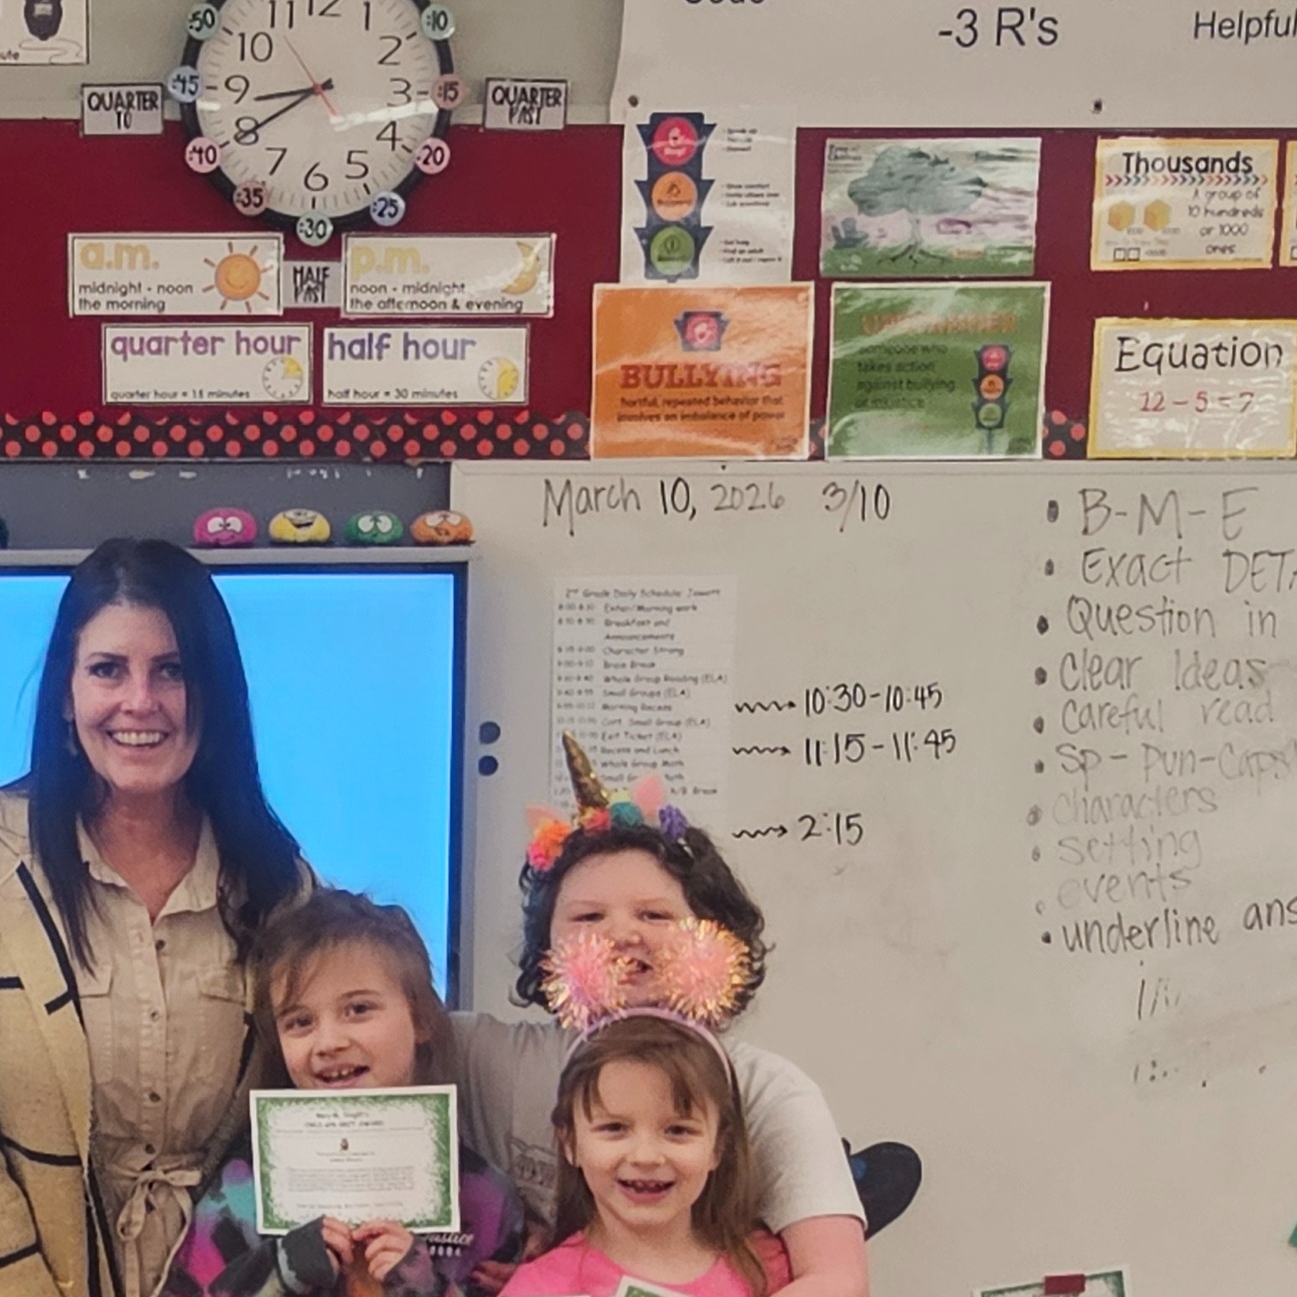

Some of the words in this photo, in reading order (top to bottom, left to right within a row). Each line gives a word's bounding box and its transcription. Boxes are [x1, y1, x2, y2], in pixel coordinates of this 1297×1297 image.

[188, 8, 215, 30] :50
[362, 2, 372, 30] 1
[426, 10, 449, 28] :10
[996, 8, 1058, 47] R's
[1194, 9, 1297, 45] Helpful
[238, 33, 273, 61] 10
[378, 36, 403, 65] 2
[172, 73, 199, 94] :45
[224, 75, 250, 104] 9
[391, 78, 411, 108] 3
[438, 82, 459, 101] :15
[491, 86, 563, 107] QUARTER
[87, 92, 159, 111] QUARTER
[508, 106, 542, 124] PAST
[115, 111, 132, 128] TO
[376, 121, 403, 150] 4
[188, 144, 217, 165] :40
[265, 147, 287, 175] 7
[345, 150, 368, 179] 5
[417, 144, 444, 166] :20
[1122, 151, 1253, 174] Thousands
[304, 162, 328, 190] 6
[236, 187, 263, 207] :35
[373, 199, 398, 218] :25
[1205, 189, 1242, 204] group
[1246, 187, 1261, 199] of
[1188, 205, 1200, 217] 10
[1204, 204, 1264, 218] hundreds
[298, 218, 328, 239] :30
[1200, 226, 1214, 236] or
[1219, 223, 1249, 236] 1000
[79, 242, 160, 270] a.m.
[351, 244, 430, 280] p.m.
[1205, 243, 1236, 254] ones
[78, 281, 142, 295] midnight
[156, 283, 194, 295] noon
[292, 266, 330, 286] HALF
[350, 282, 386, 295] noon
[402, 281, 465, 295] midnight
[78, 298, 101, 311] the
[105, 298, 165, 314] morning
[349, 298, 374, 311] the
[378, 296, 447, 312] afternoon
[466, 298, 524, 314] evening
[110, 331, 225, 359] quarter
[235, 330, 302, 356] hour
[328, 332, 391, 361] half
[402, 333, 476, 361] hour
[1115, 336, 1284, 375] Equation
[620, 362, 782, 389] BULLYING
[543, 478, 641, 535] March
[660, 477, 697, 520] 10,
[710, 481, 785, 510] 2026
[822, 479, 890, 532] 3/10
[1082, 545, 1191, 588] Exact
[1067, 594, 1216, 640] Question
[1244, 600, 1277, 638] in
[1201, 690, 1274, 725] read
[798, 813, 863, 845] 2:15
[1058, 825, 1202, 870] setting
[1058, 863, 1192, 909] events
[1062, 907, 1219, 953] underline
